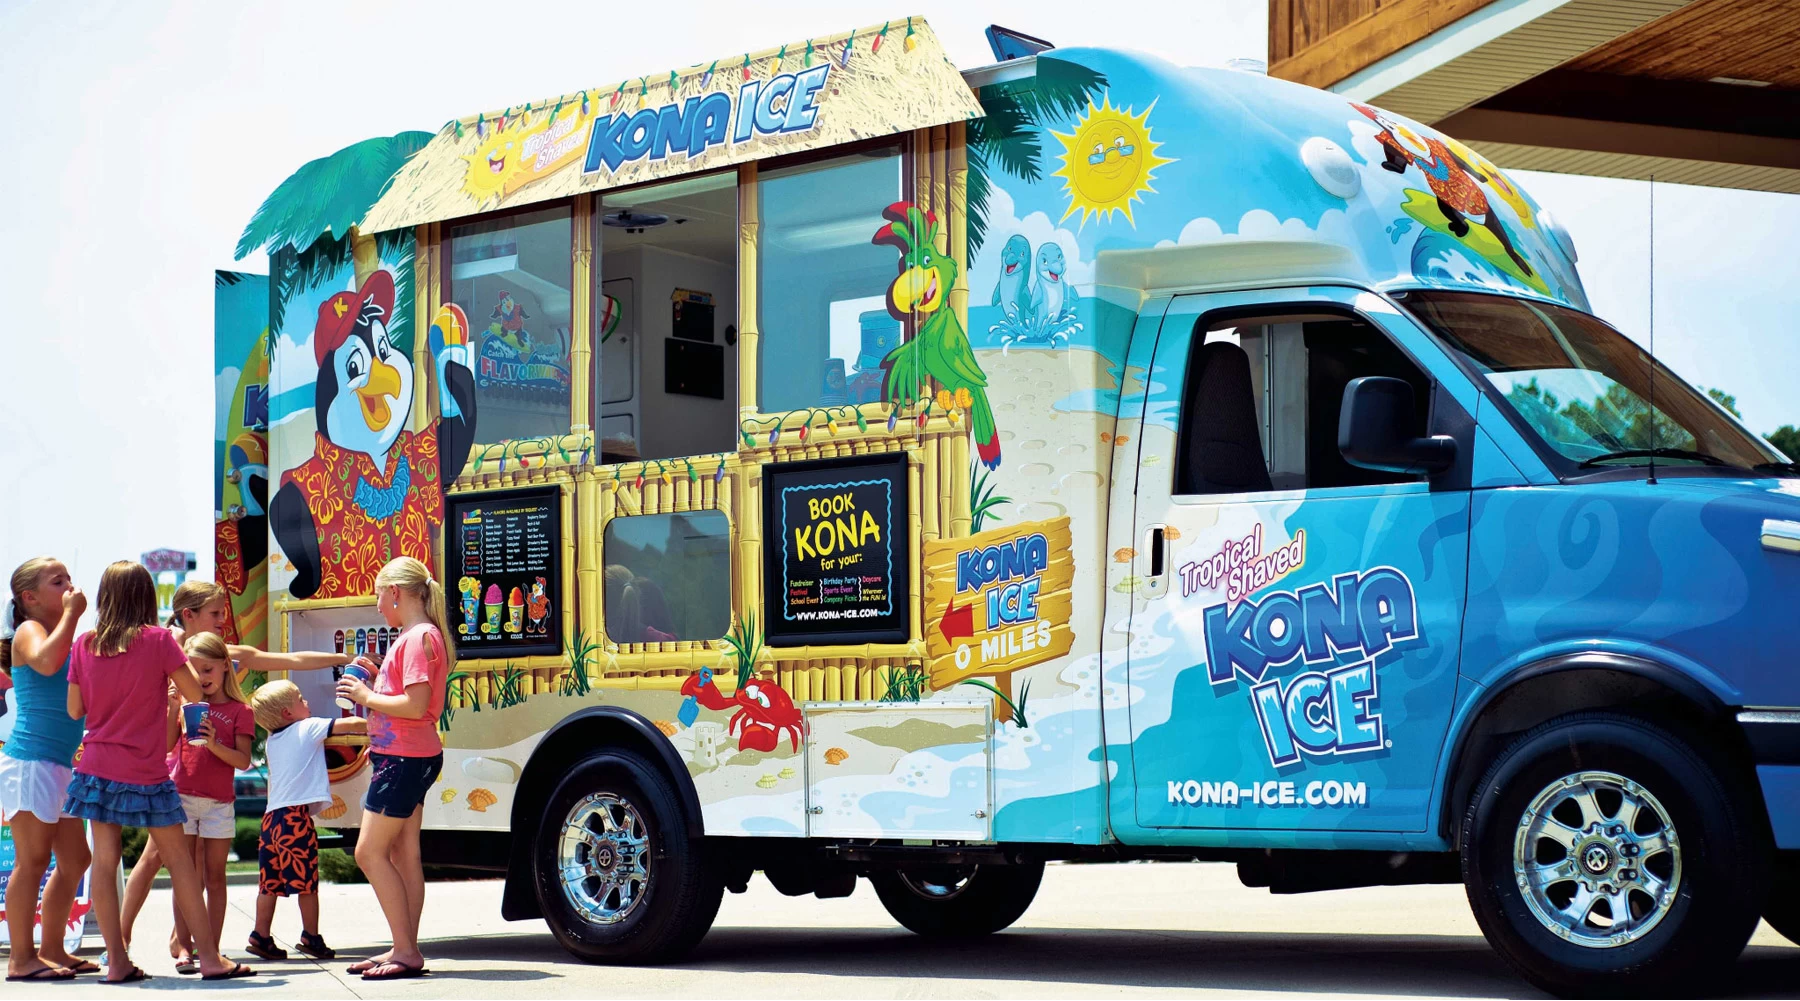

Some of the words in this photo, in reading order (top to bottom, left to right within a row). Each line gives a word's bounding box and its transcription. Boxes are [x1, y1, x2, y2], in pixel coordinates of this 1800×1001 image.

[583, 91, 731, 175] KONA
[732, 63, 831, 144] ICE
[808, 492, 855, 520] BOOK
[795, 510, 880, 562] KONA
[821, 558, 835, 571] for
[838, 553, 863, 570] your:
[956, 532, 1049, 595] KONA
[1179, 523, 1262, 598] Tropical
[1227, 529, 1305, 601] Shaved
[790, 580, 814, 588] Fundraiser
[823, 578, 843, 586] Birthday
[844, 576, 858, 585] Party
[823, 587, 839, 596] Sports
[840, 586, 853, 594] Event
[862, 576, 882, 584] Daycare
[790, 597, 805, 605] School
[823, 596, 843, 604] Company
[986, 574, 1043, 632] ICE
[796, 608, 878, 621] WWW.KONA-ICE.COM
[1203, 566, 1419, 685] KONA
[981, 619, 1052, 663] MILES
[1250, 657, 1385, 768] ICE
[1167, 780, 1367, 804] KONA-ICE.COM
